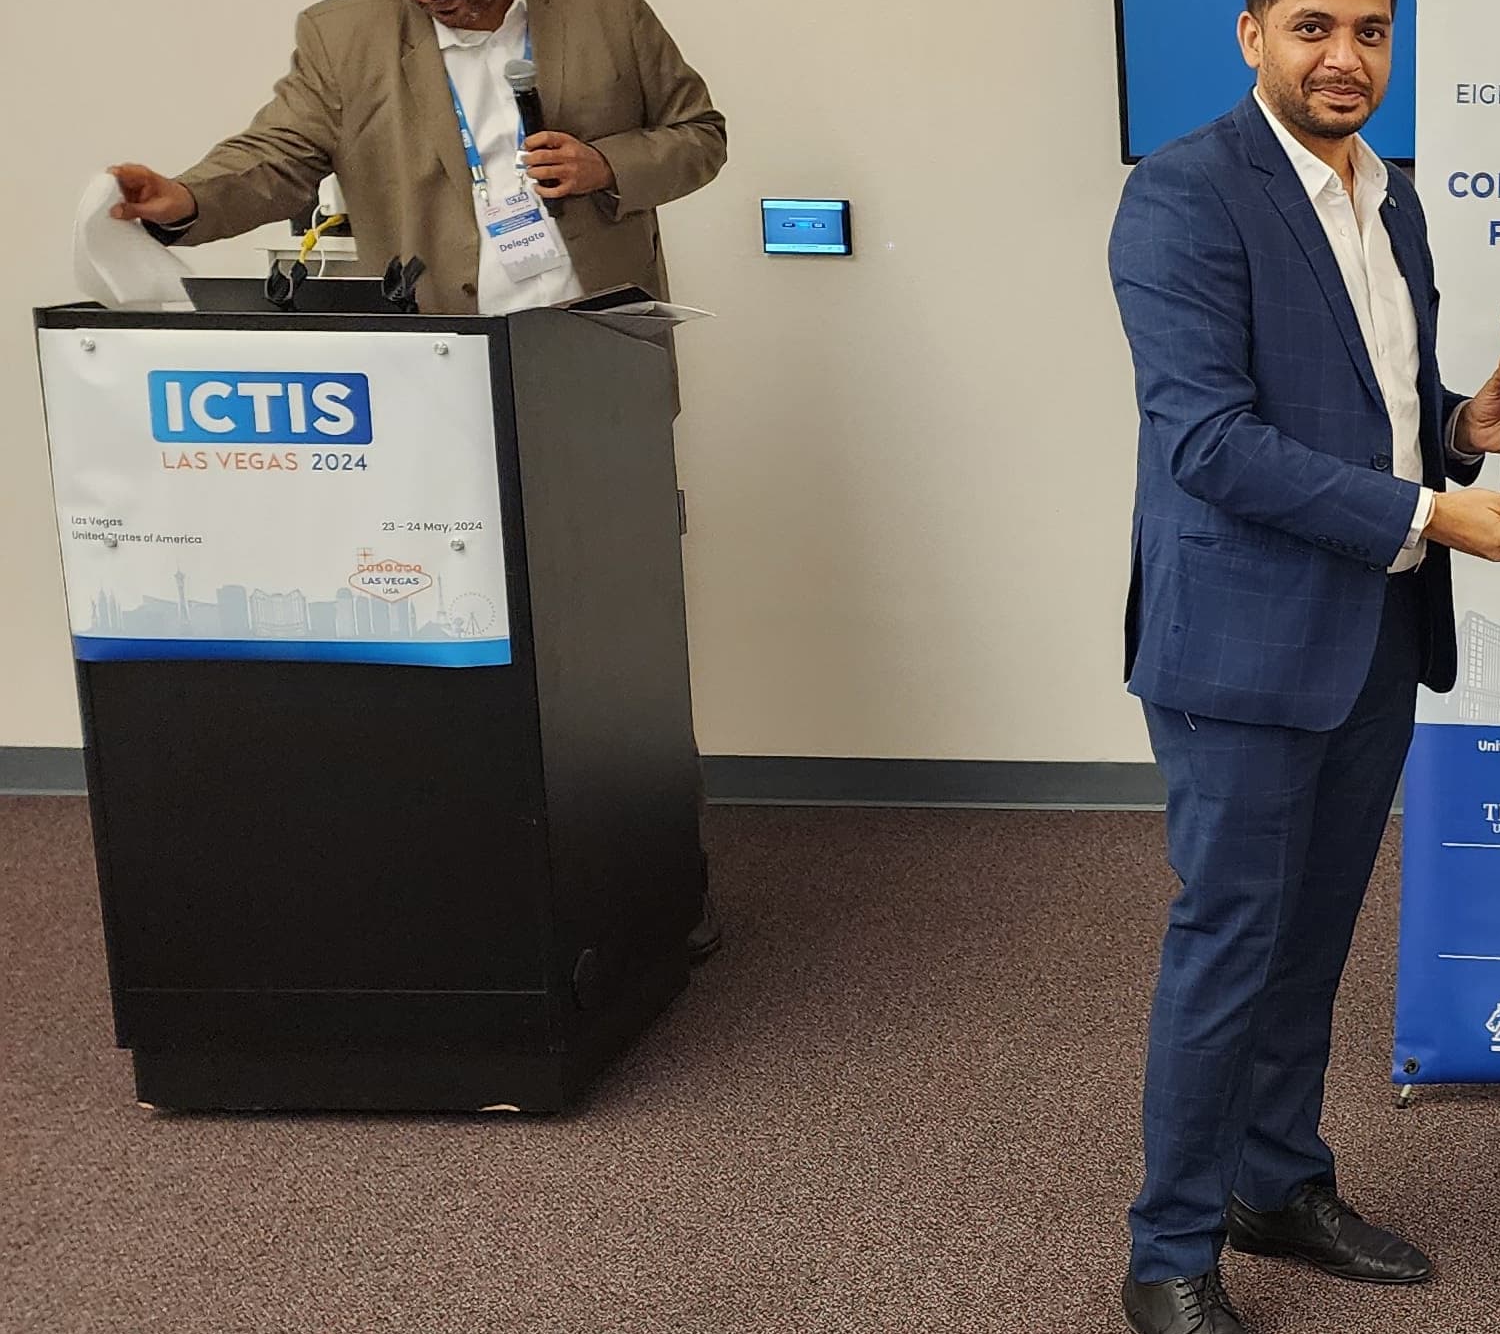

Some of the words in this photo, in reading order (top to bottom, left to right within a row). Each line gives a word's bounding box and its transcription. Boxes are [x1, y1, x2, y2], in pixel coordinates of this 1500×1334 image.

[499, 232, 545, 252] Delegate
[164, 380, 355, 436] ICTIS
[162, 451, 208, 471] LAS
[215, 452, 298, 471] VEGAS
[311, 453, 367, 471] 2024
[71, 516, 87, 525] Las
[89, 517, 123, 528] Vegas
[382, 522, 395, 531] 23
[407, 522, 420, 531] 24
[424, 522, 452, 534] May,
[454, 521, 483, 531] 2024
[72, 530, 105, 541] United
[144, 533, 153, 543] of
[156, 534, 202, 544] America
[361, 577, 381, 585] LAS
[384, 577, 419, 585] VEGAS
